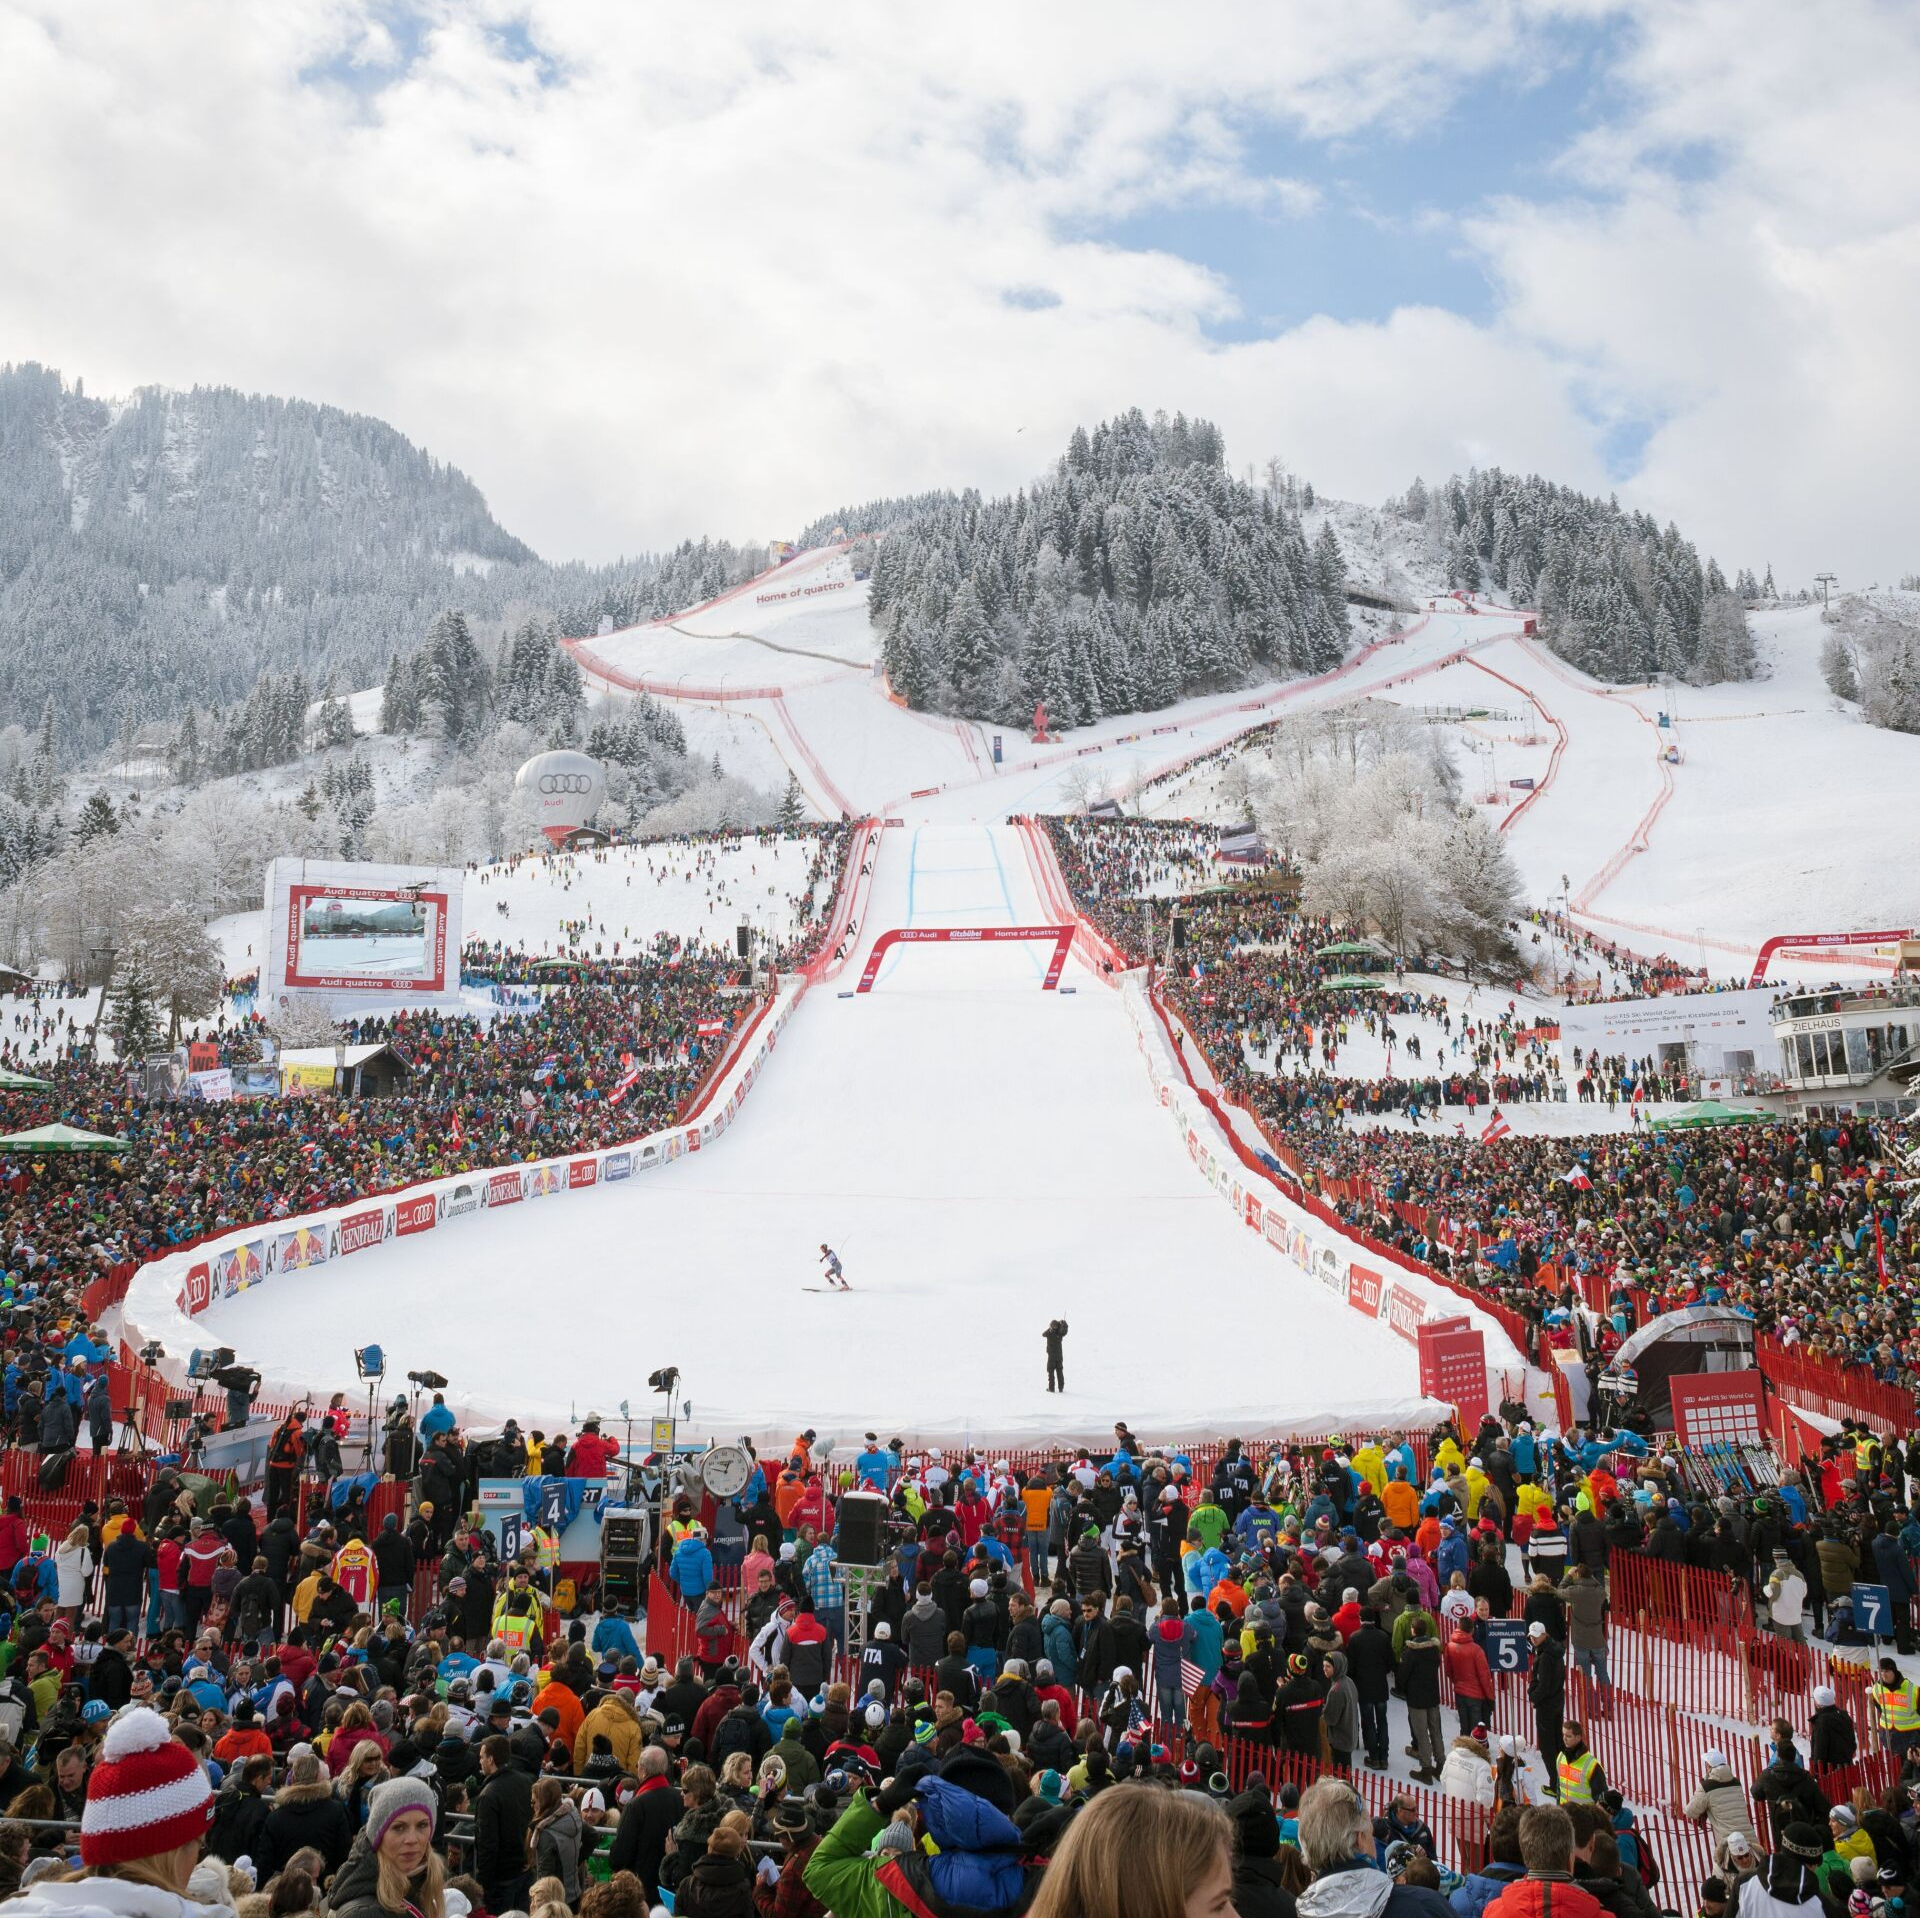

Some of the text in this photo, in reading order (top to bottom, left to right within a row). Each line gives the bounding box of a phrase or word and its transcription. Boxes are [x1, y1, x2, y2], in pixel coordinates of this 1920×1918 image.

[756, 581, 844, 604] Home of quattro
[323, 887, 387, 898] Audi quattro
[287, 903, 298, 967] Audi quattro
[1030, 929, 1060, 937] quattro
[345, 979, 383, 988] quattro
[1793, 1018, 1841, 1032] ZIELHAUS
[192, 1056, 213, 1072] WC
[398, 1212, 409, 1221] Audi
[398, 1220, 413, 1230] quattro
[342, 1220, 383, 1252] GENERALI
[1227, 1463, 1238, 1473] IT
[1235, 1478, 1249, 1491] ITA
[1120, 1486, 1136, 1497] ITA
[1220, 1488, 1233, 1500] ITA
[547, 1498, 560, 1523] 4
[506, 1530, 516, 1559] 9
[713, 1536, 744, 1544] LONGINES
[1862, 1601, 1881, 1630] 7
[863, 1648, 883, 1665] ITA
[1498, 1638, 1519, 1669] 5
